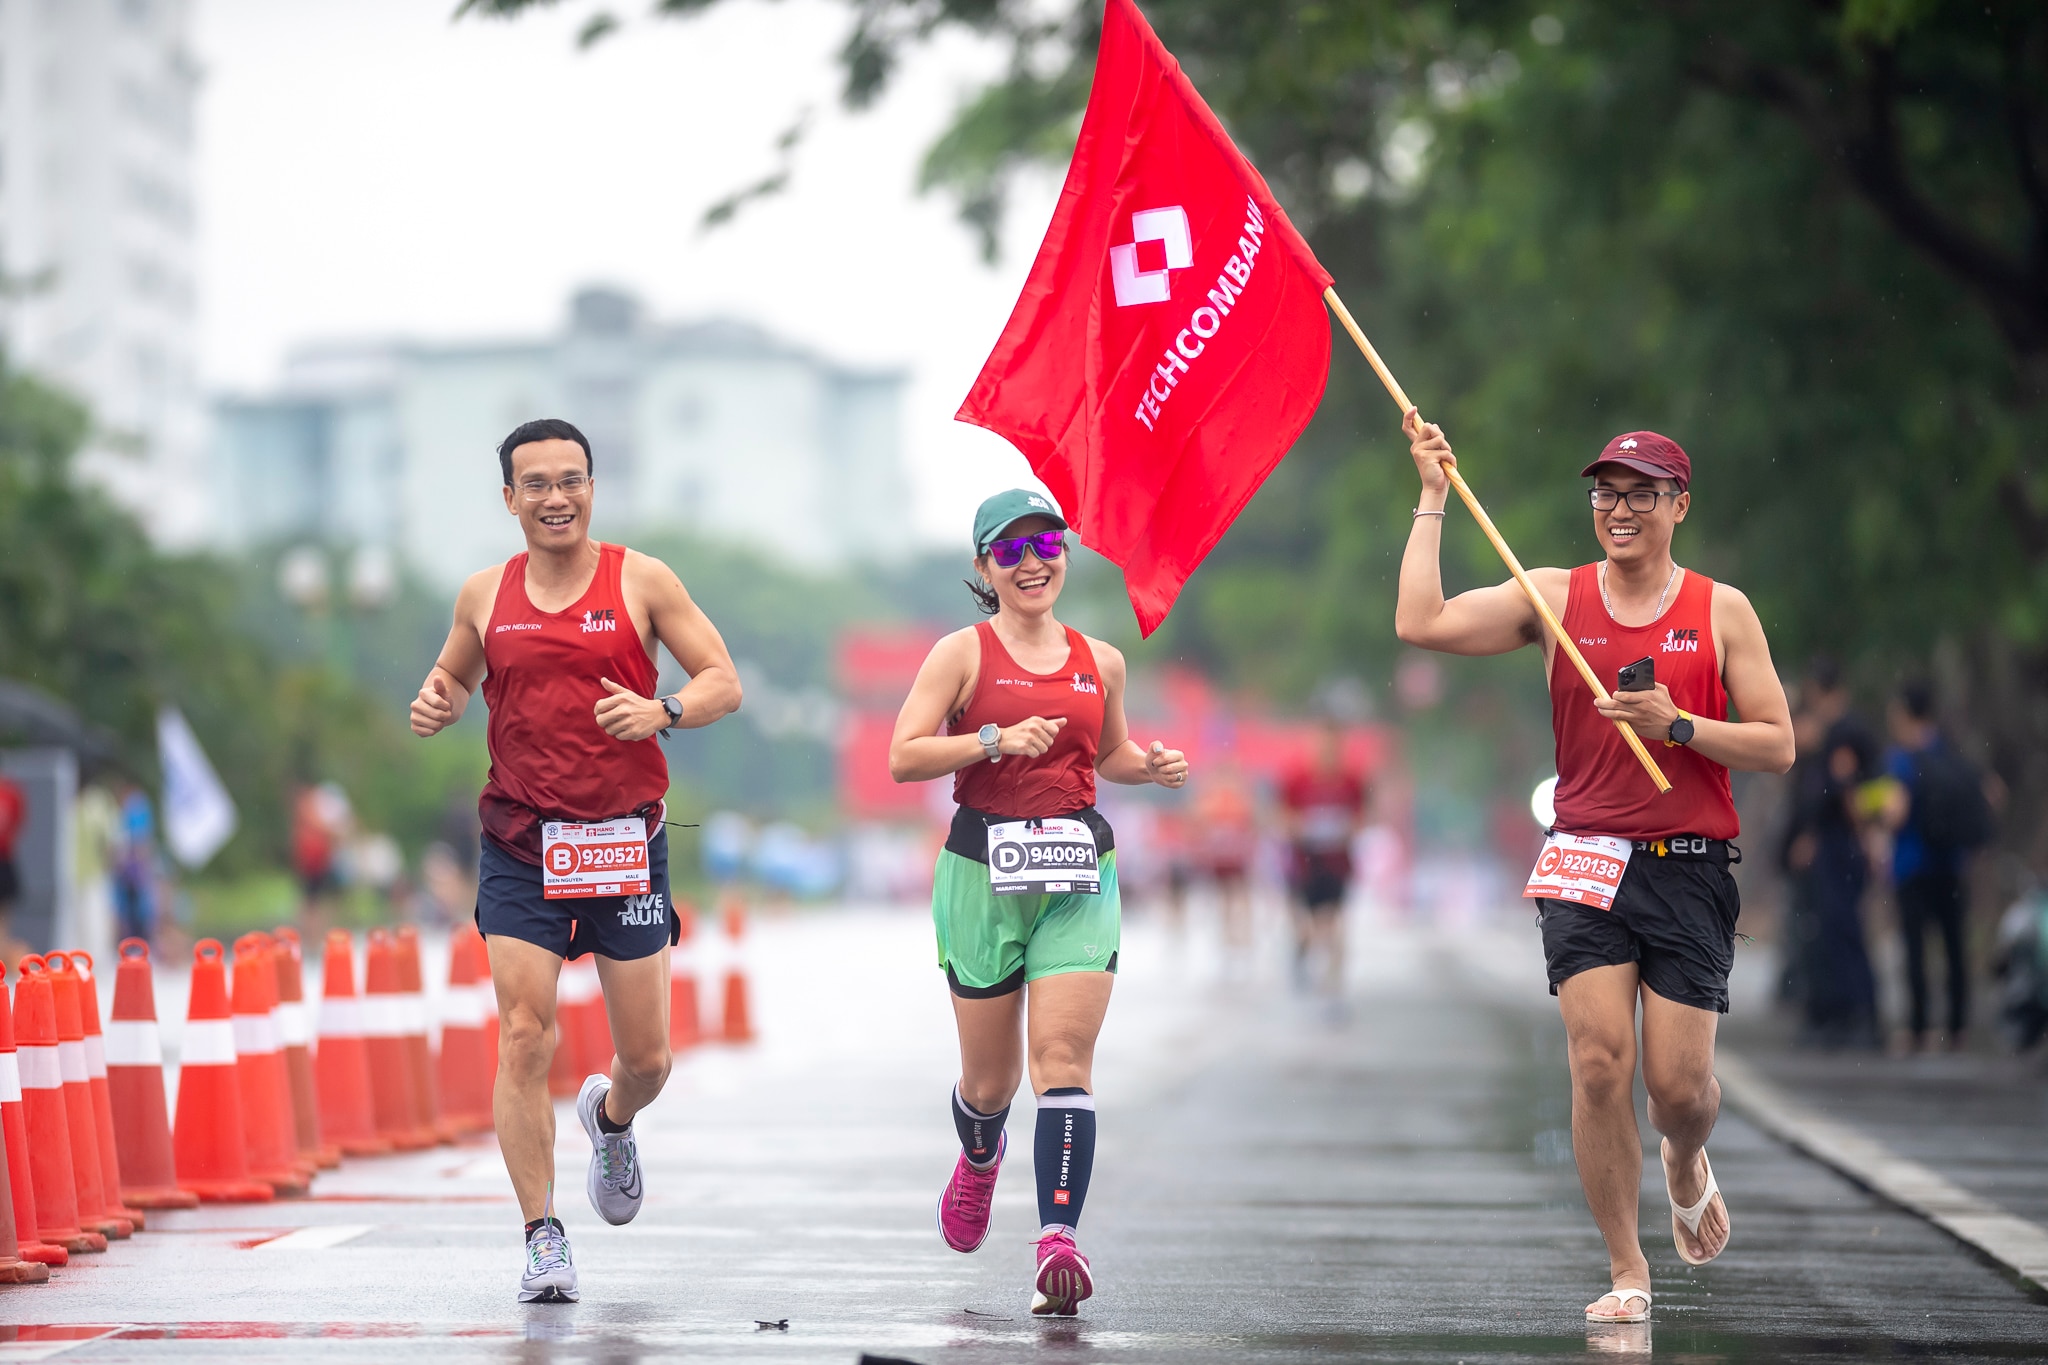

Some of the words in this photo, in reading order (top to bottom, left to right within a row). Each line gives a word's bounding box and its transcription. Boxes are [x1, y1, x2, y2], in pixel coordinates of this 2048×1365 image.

[1134, 194, 1265, 432] TECHCOMBANK
[590, 609, 615, 620] WE
[495, 624, 511, 633] BIEN
[511, 623, 542, 631] NGUYEN
[581, 619, 616, 633] RUN
[1672, 629, 1698, 640] WE
[1579, 637, 1595, 646] Huy
[1661, 640, 1698, 652] RUN
[1014, 679, 1033, 687] Trang
[1079, 673, 1096, 684] WE
[1071, 682, 1097, 694] RUN
[553, 849, 572, 870] B
[582, 846, 644, 865] 920527
[998, 847, 1020, 868] D
[1030, 846, 1094, 864] 940091
[1541, 852, 1557, 872] C
[1563, 853, 1621, 879] 920138
[1590, 884, 1606, 893] MALE
[635, 894, 664, 909] WE
[622, 908, 664, 926] RUN
[1060, 1113, 1073, 1187] COMPRESSPORT
